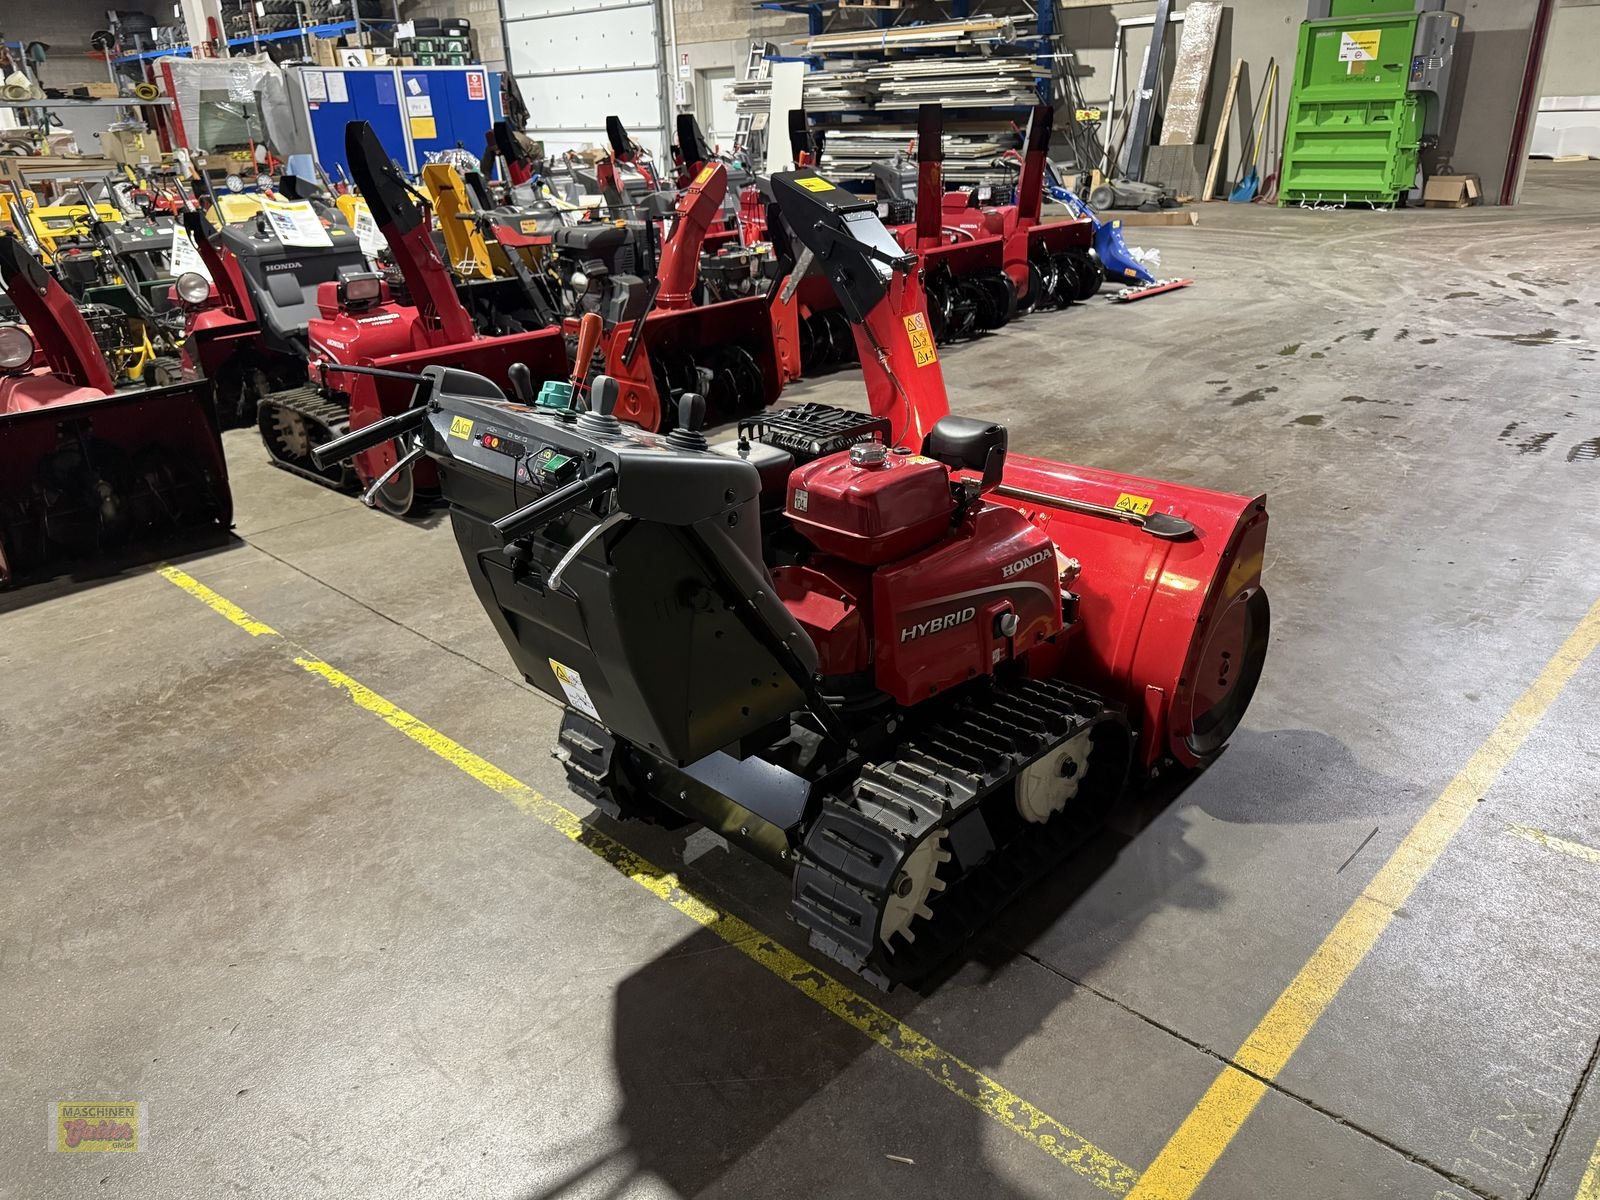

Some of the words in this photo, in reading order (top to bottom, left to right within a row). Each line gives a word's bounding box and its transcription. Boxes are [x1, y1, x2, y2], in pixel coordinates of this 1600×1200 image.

[265, 261, 303, 272] HONDA
[326, 338, 345, 350] HONDA
[1001, 547, 1053, 578] HONDA
[900, 607, 976, 643] HYBRID
